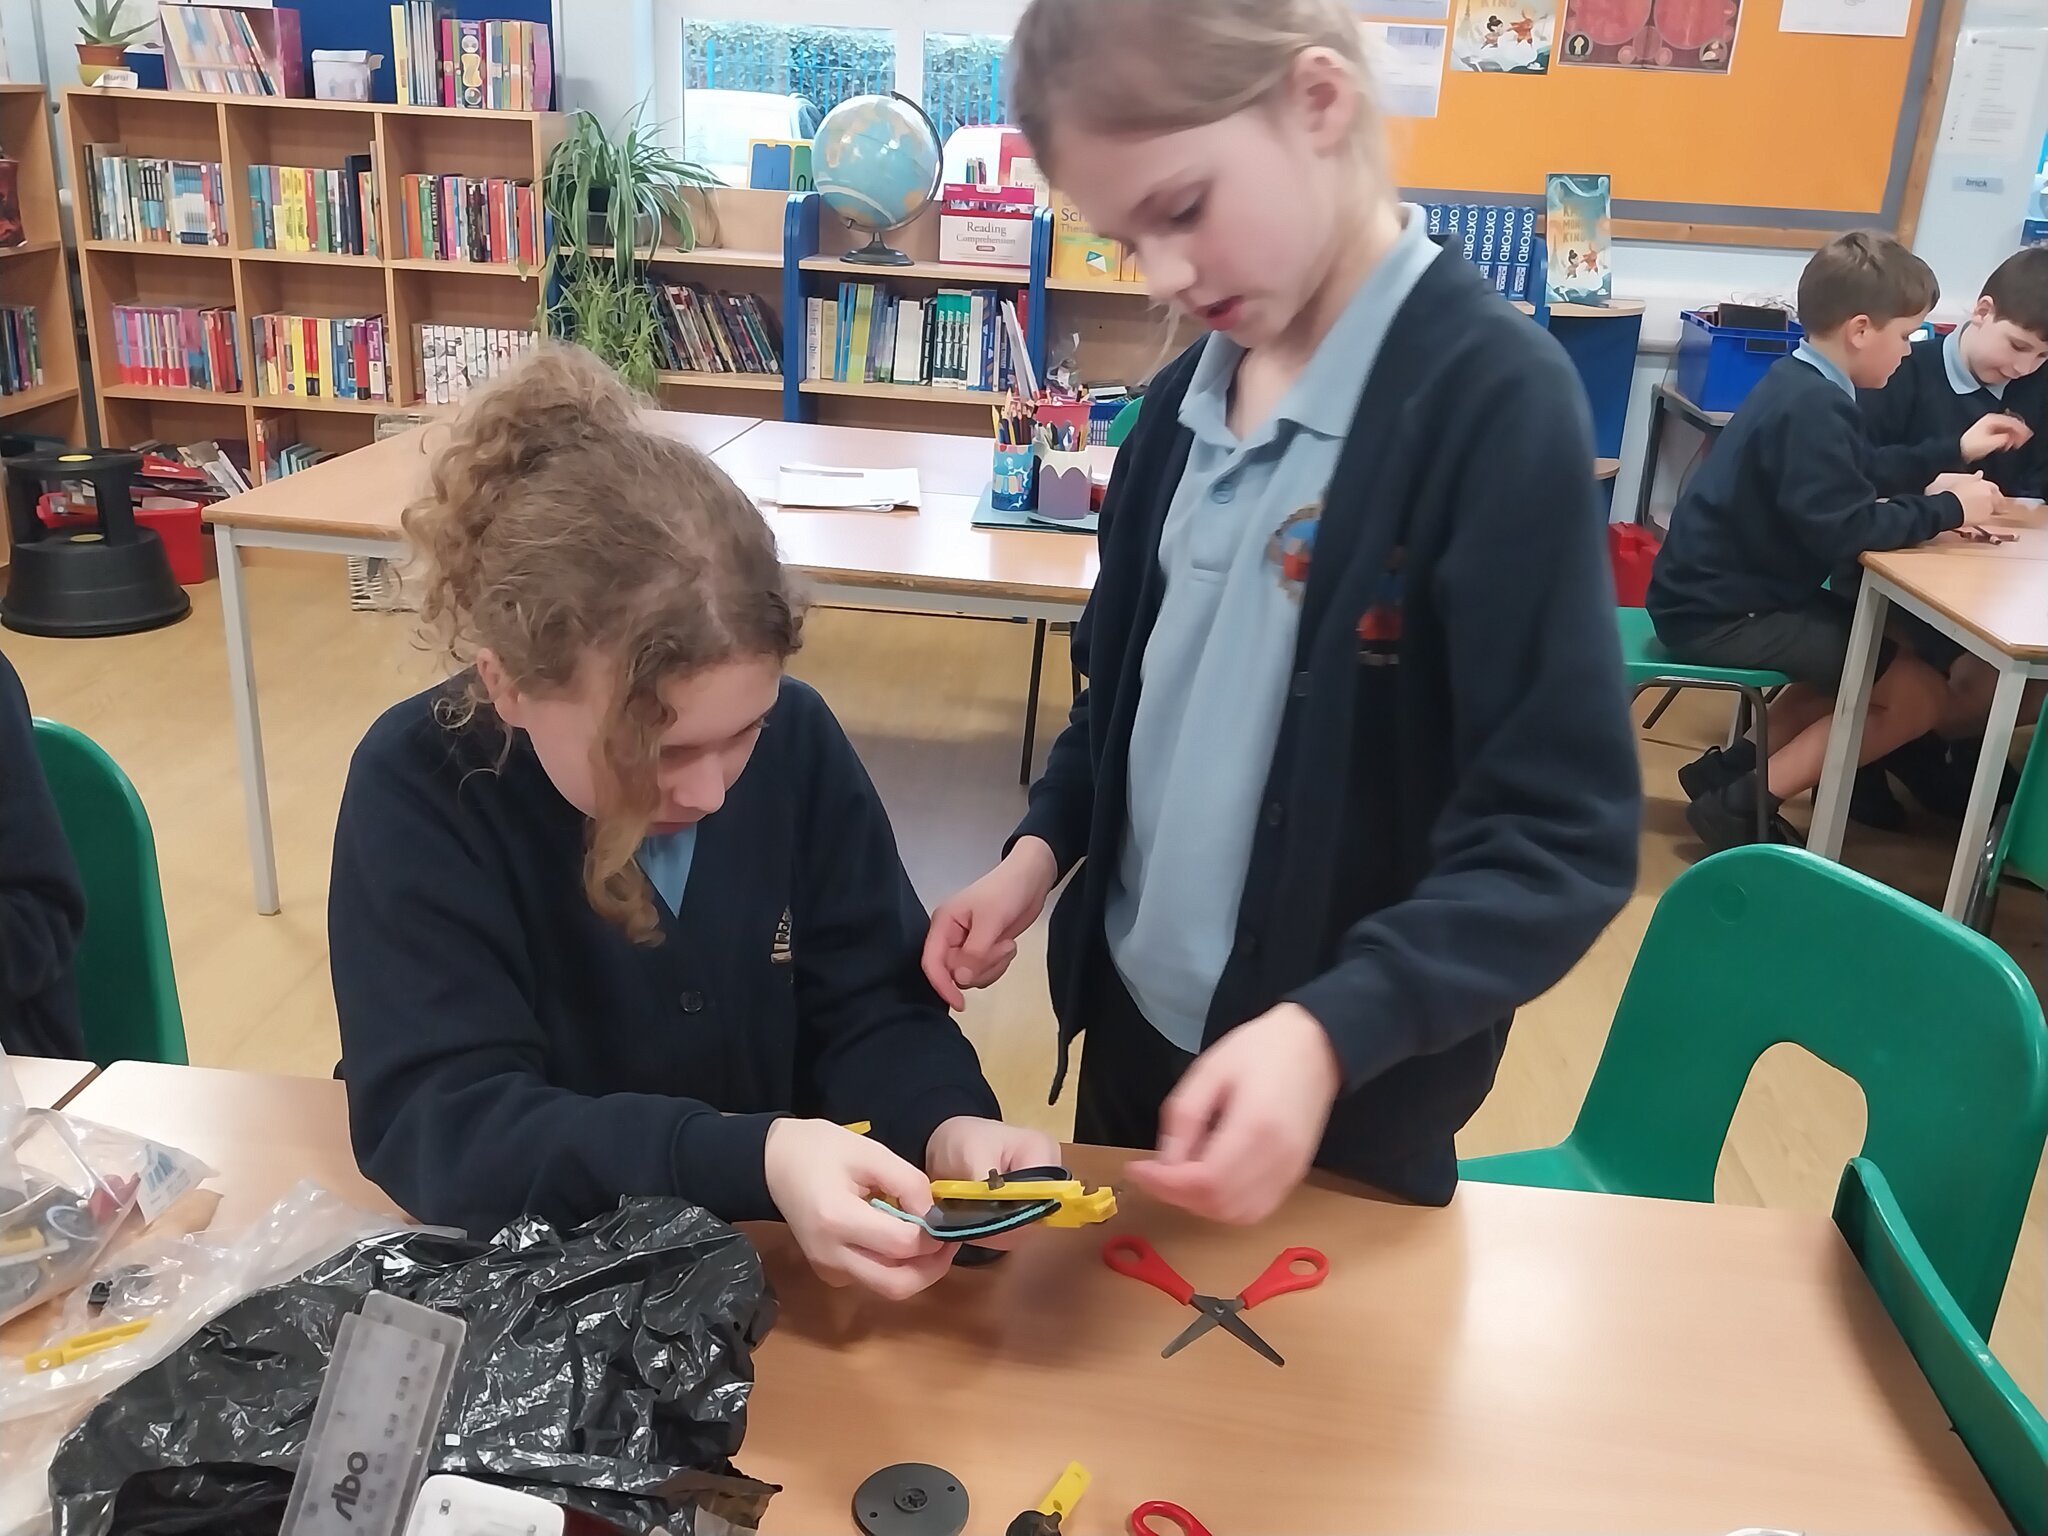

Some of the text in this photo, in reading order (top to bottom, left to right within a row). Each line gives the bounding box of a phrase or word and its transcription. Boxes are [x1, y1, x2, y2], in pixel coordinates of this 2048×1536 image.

[956, 234, 1016, 245] Comprehension
[967, 221, 1007, 235] Reading
[1429, 208, 1442, 234] OXF
[1448, 209, 1460, 233] OXF
[1463, 210, 1478, 260] OXFORD
[1481, 211, 1497, 261] OXFORD
[1499, 211, 1515, 261] OXFORD
[1518, 212, 1534, 262] OXFORD
